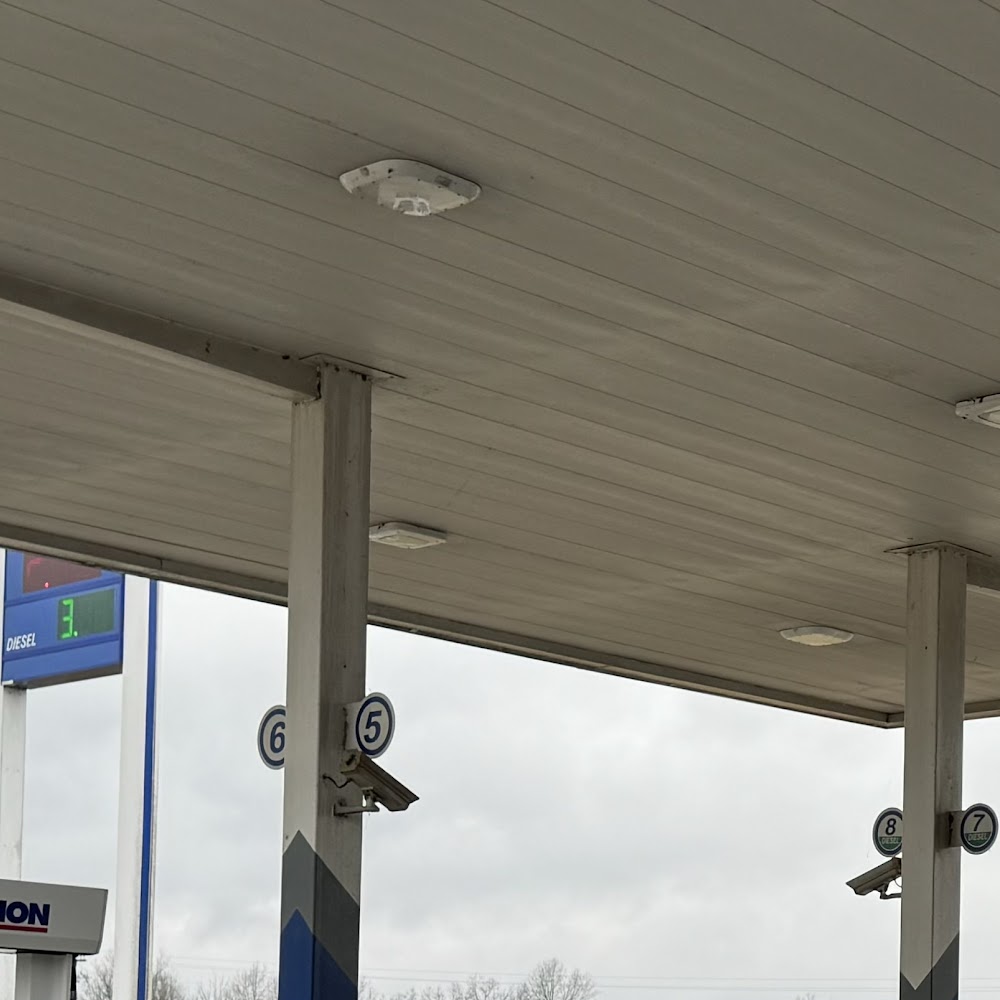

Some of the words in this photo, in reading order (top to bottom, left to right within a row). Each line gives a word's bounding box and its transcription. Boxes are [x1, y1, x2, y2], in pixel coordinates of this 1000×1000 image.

[6, 633, 37, 652] DIESEL
[363, 710, 382, 744] 5
[269, 721, 286, 754] 6
[885, 818, 897, 836] 8
[973, 814, 986, 832] 7
[881, 837, 900, 845] DIESEL
